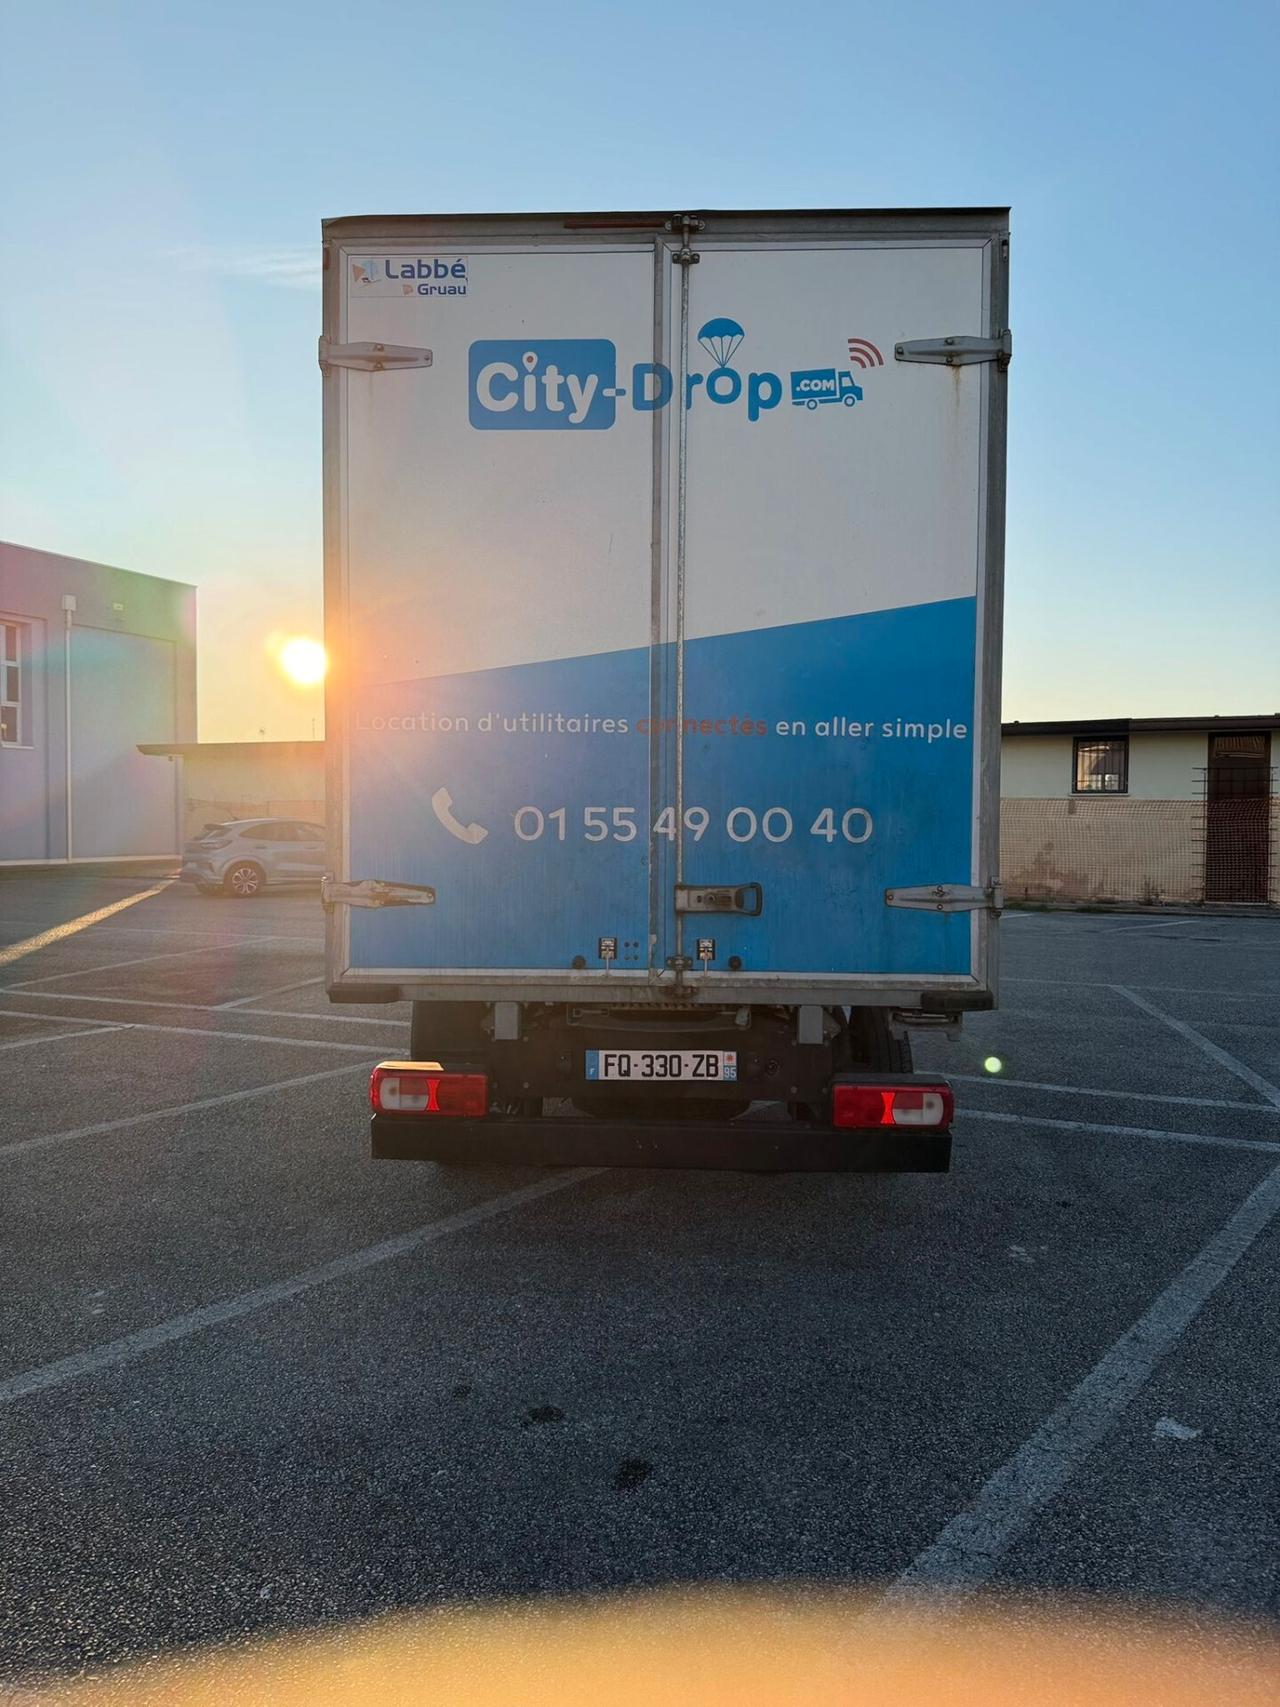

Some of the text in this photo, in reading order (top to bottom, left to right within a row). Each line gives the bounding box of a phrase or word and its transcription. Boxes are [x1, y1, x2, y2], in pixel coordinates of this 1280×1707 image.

[384, 258, 466, 279] Labbé
[417, 283, 467, 295] Gruau
[356, 712, 469, 732] Location
[478, 712, 629, 733] d'utilitaires
[775, 719, 806, 736] en
[814, 716, 874, 737] aller
[882, 718, 967, 744] simple
[513, 806, 874, 843] 01 55 49 00 40
[604, 1054, 719, 1077] FQ-330-ZB
[724, 1067, 736, 1079] 95
